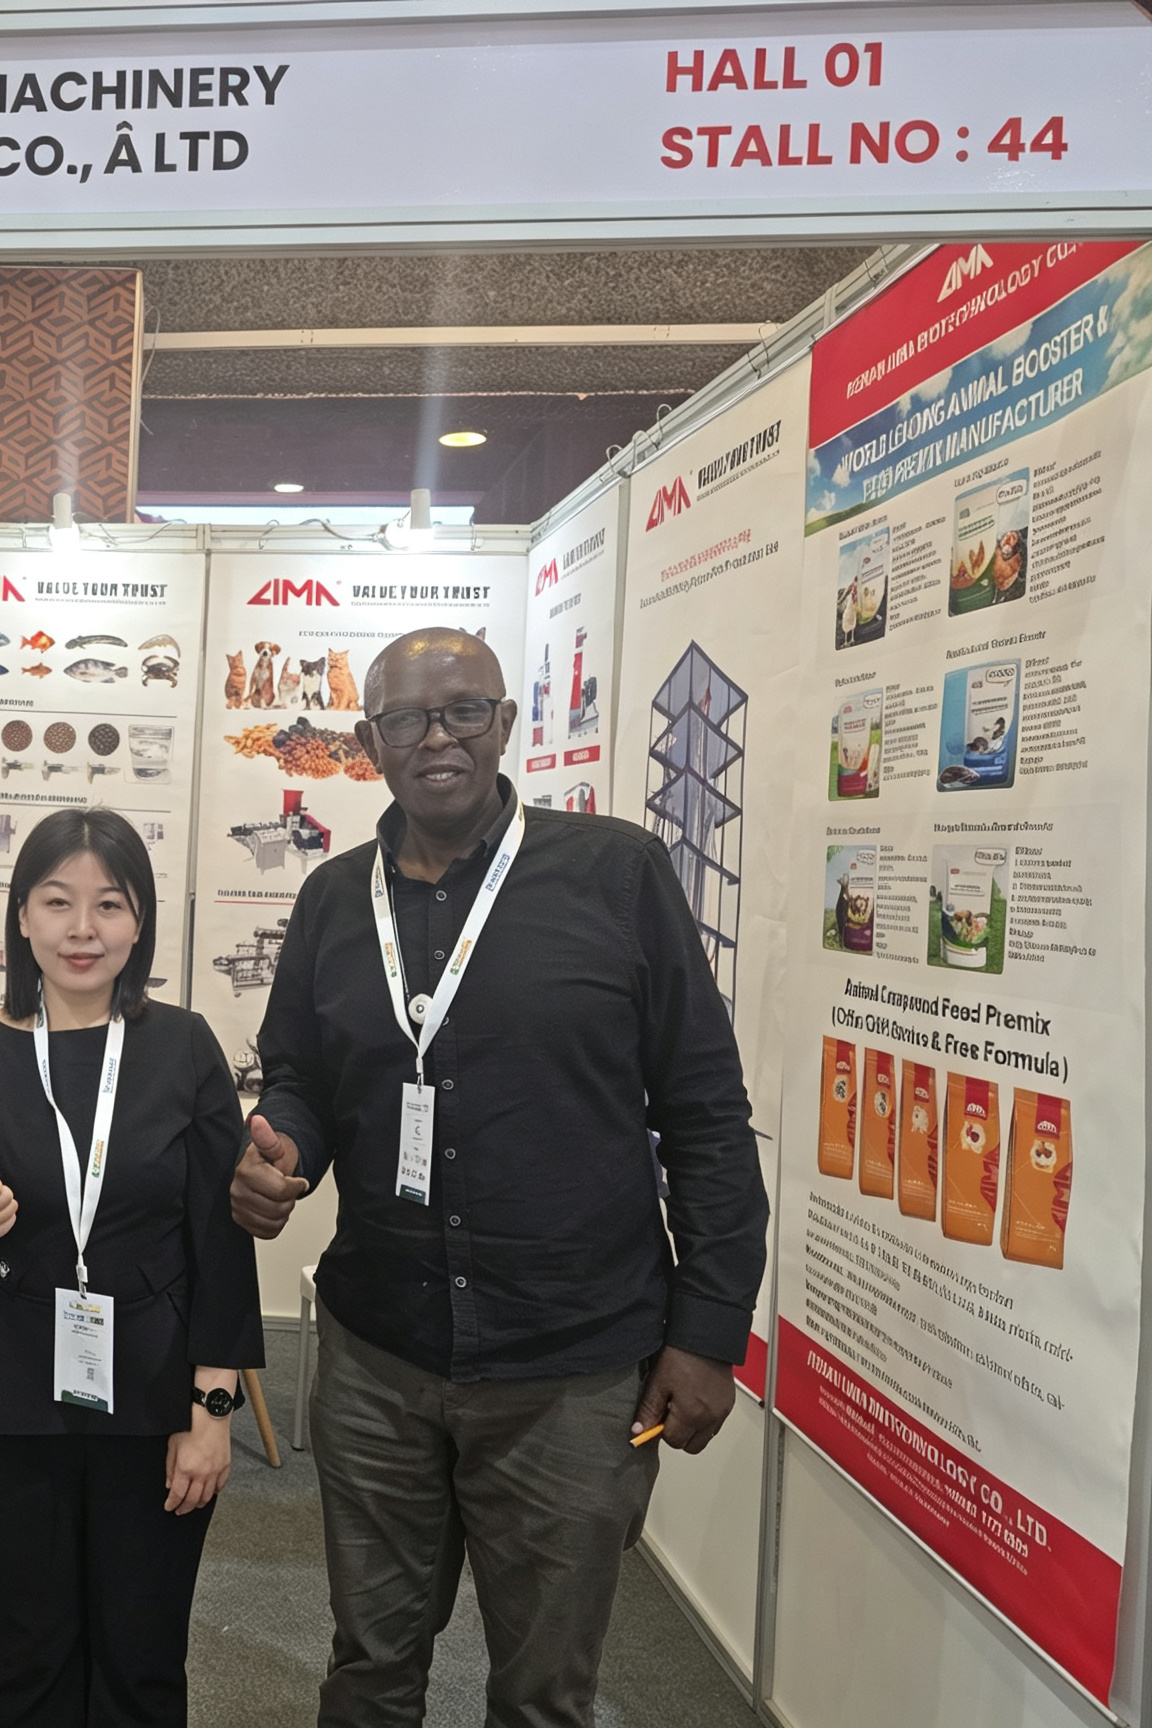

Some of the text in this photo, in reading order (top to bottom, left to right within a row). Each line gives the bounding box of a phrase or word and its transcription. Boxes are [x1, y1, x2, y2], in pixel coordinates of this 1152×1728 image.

[665, 42, 883, 93] HALL 01
[155, 130, 250, 174] LTD
[660, 122, 833, 169] STALL
[848, 119, 941, 165] NO
[986, 116, 1069, 162] 44
[1011, 313, 1094, 388] BOOSTER
[942, 998, 981, 1024] Feed
[985, 1004, 1052, 1037] Premix
